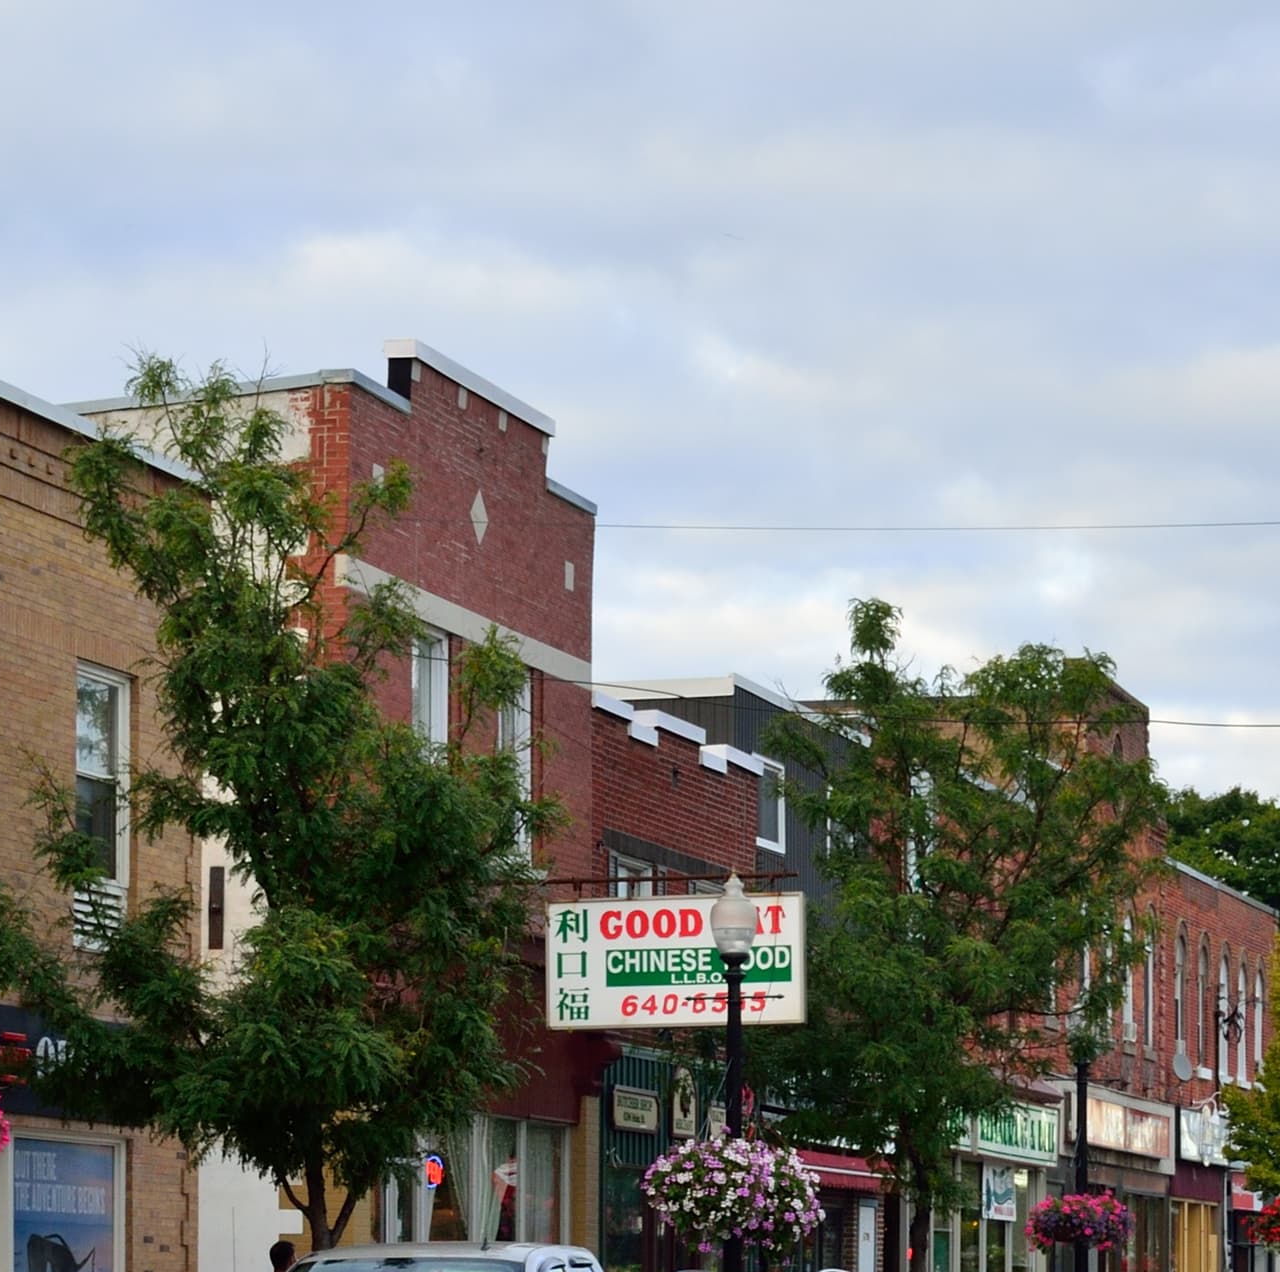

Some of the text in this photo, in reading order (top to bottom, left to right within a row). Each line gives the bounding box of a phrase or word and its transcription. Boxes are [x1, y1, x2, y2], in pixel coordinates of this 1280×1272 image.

[600, 908, 703, 941] GOOD
[606, 946, 790, 974] CHINESE OOD
